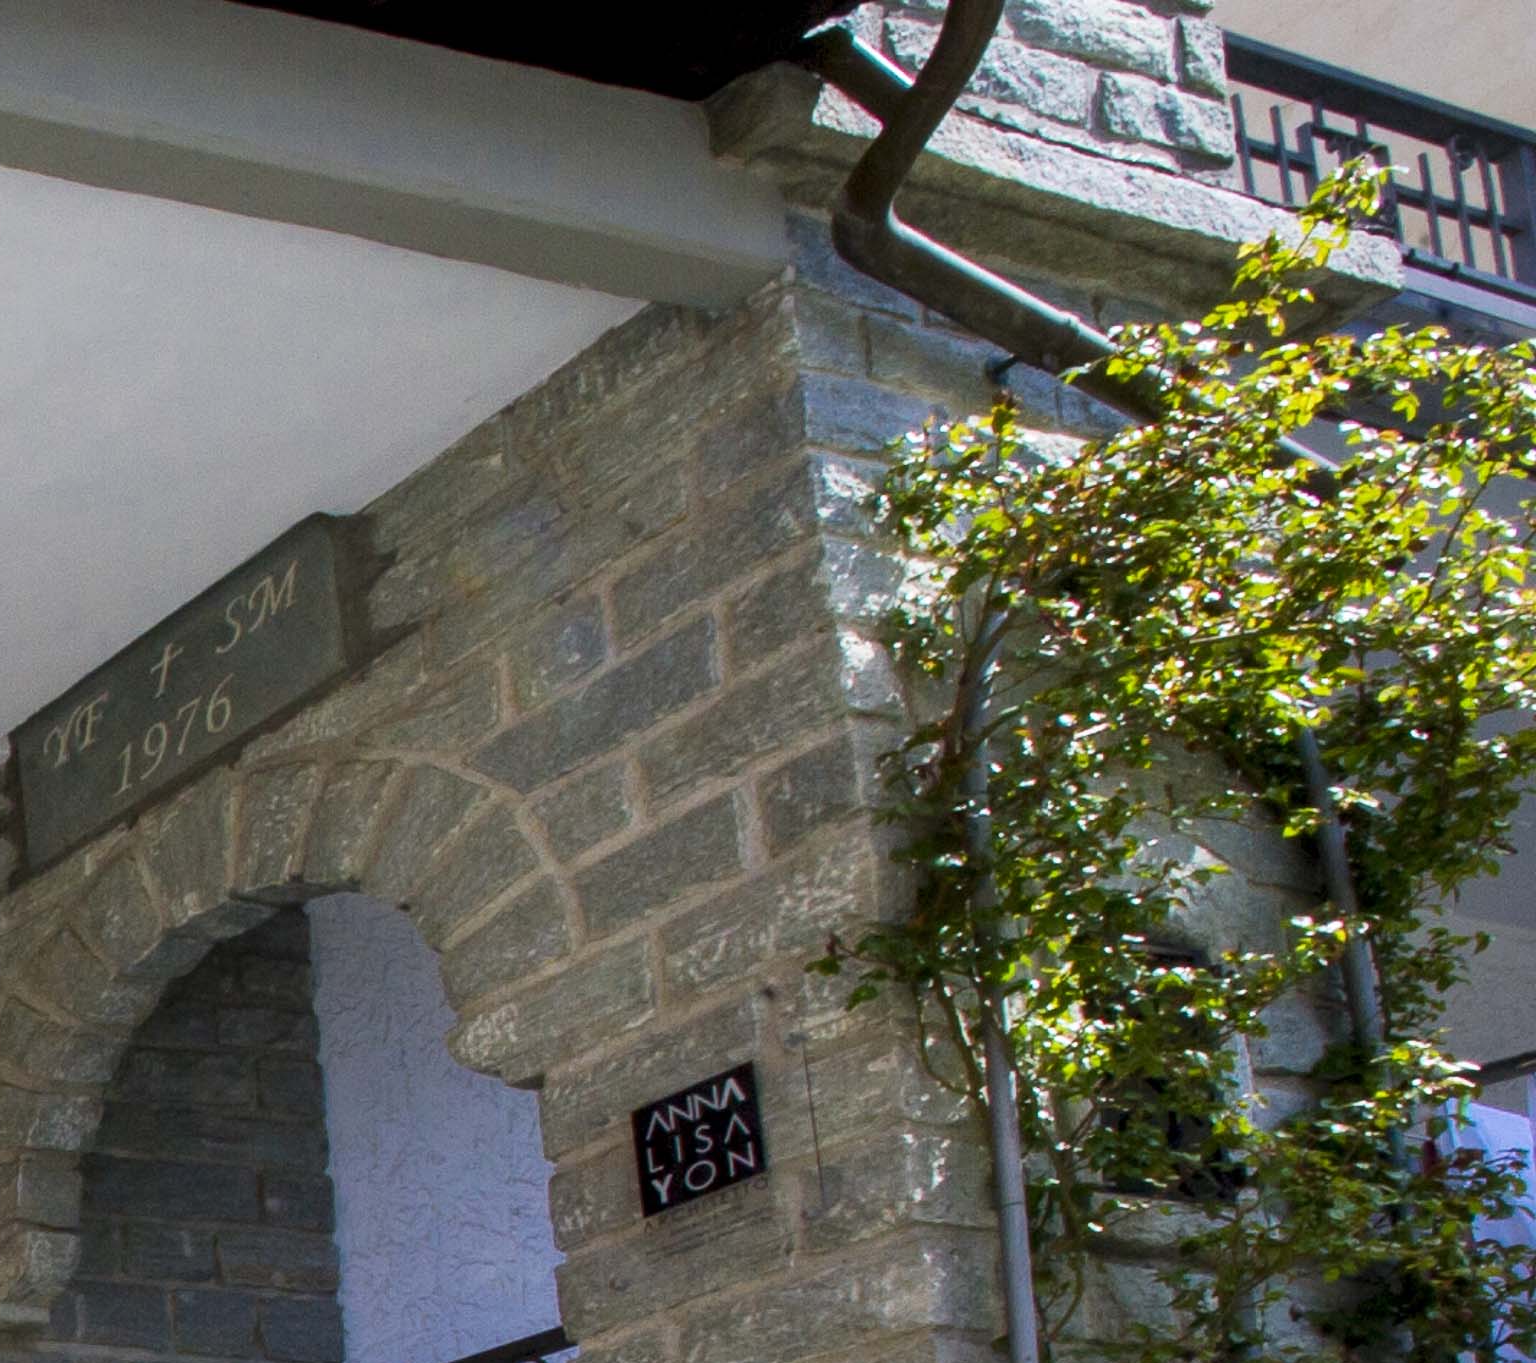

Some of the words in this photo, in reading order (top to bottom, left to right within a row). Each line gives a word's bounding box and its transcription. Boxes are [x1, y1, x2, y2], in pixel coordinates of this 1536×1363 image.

[216, 558, 298, 654] SM
[114, 673, 235, 797] 1976
[646, 1077, 746, 1142] ANNA
[647, 1113, 751, 1173] LISA
[651, 1141, 756, 1205] YON
